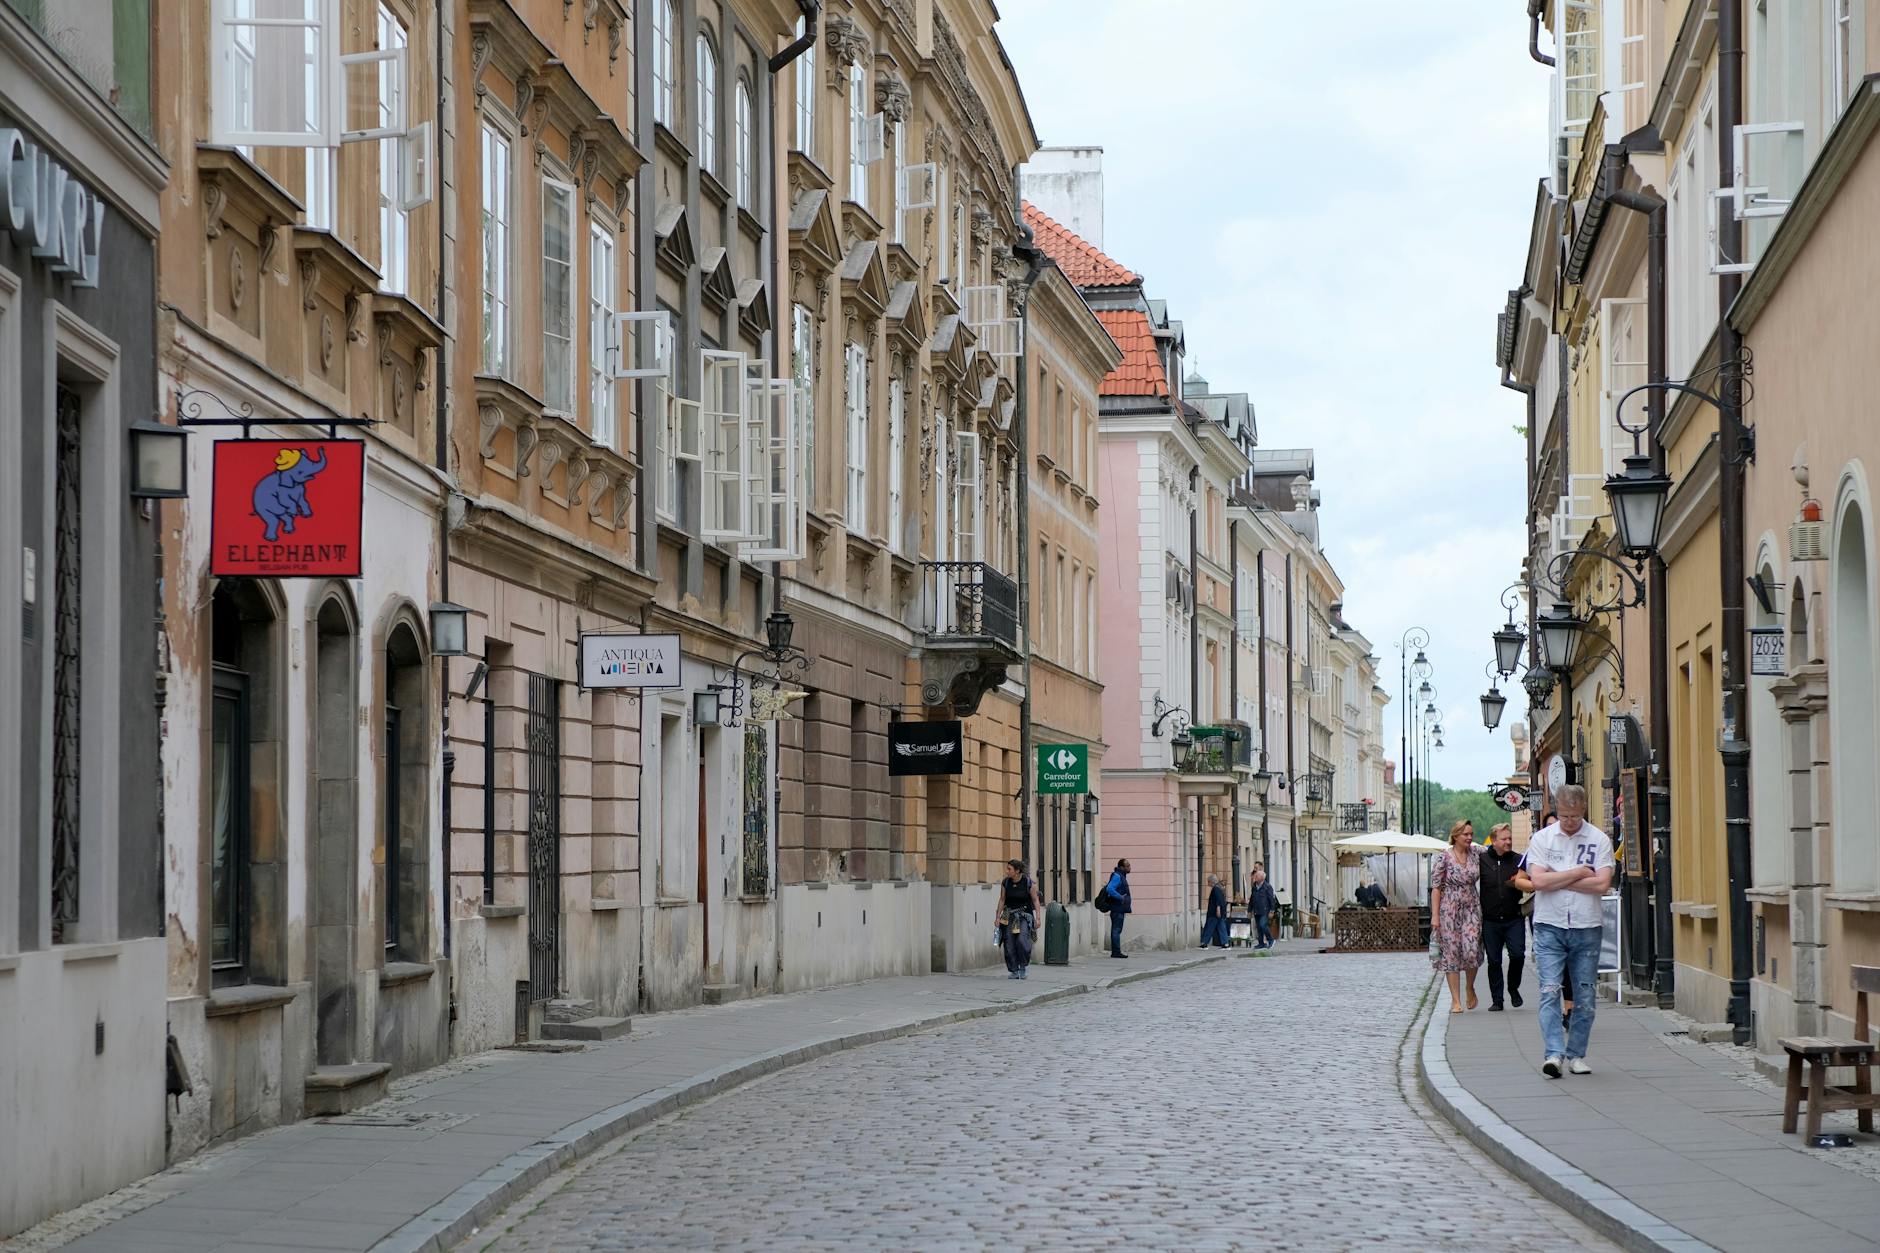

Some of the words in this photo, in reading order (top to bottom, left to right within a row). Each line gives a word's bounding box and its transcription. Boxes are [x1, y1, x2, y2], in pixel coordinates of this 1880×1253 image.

[0, 128, 105, 289] CUKRY
[227, 544, 348, 563] ELEPHANT
[601, 648, 664, 661] ANTIQUA
[600, 662, 664, 674] MODERNA
[911, 743, 939, 752] Samuel
[1043, 772, 1082, 780] Carrefour
[1050, 781, 1075, 790] express
[1576, 844, 1597, 865] 25
